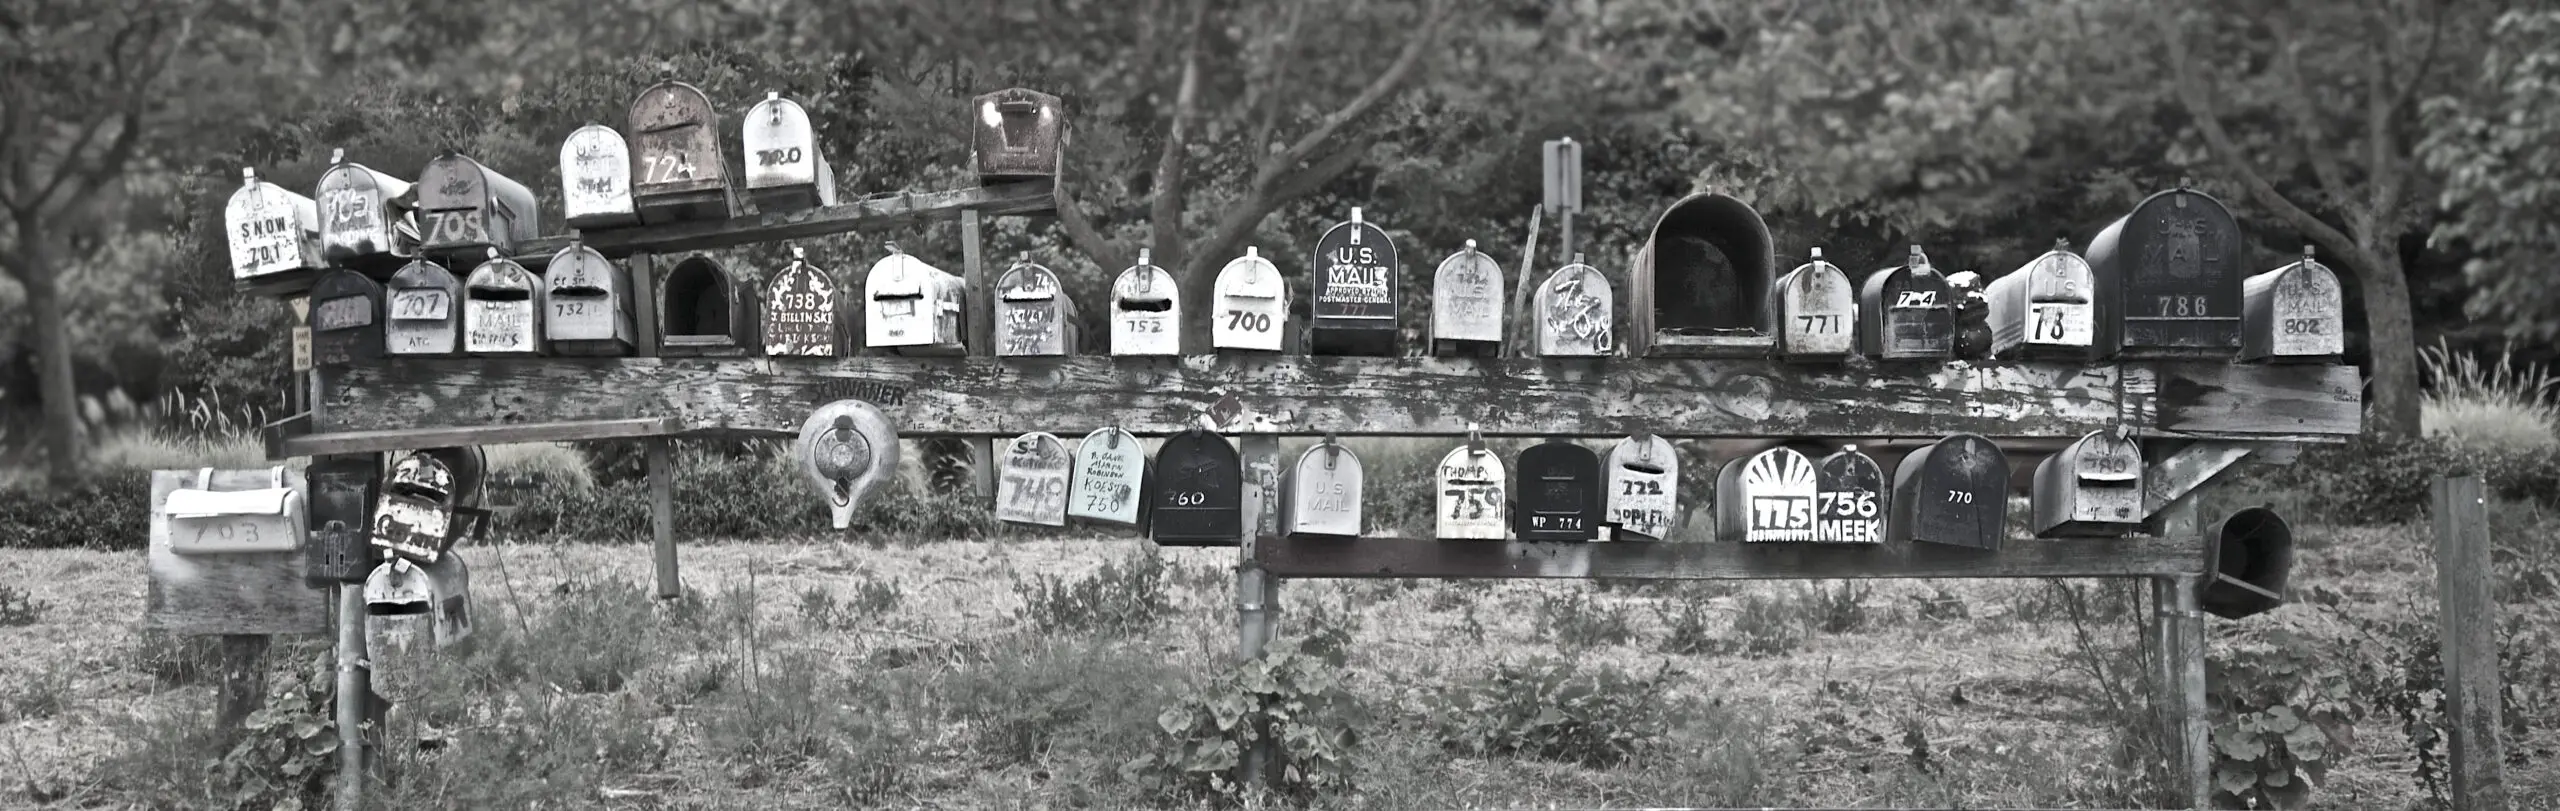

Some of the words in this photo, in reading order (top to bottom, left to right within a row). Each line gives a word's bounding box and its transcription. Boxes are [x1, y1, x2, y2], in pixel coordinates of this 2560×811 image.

[643, 155, 696, 183] 724
[241, 217, 286, 239] SNOW
[425, 211, 487, 245] 709
[249, 245, 280, 264] 701
[1339, 246, 1377, 264] U.S.
[1328, 266, 1383, 285] MAIL
[401, 293, 440, 315] 707
[785, 293, 815, 310] 738
[1319, 296, 1362, 304] POSTMASTER
[1364, 296, 1392, 304] GENERAL
[2159, 295, 2208, 316] 786
[2287, 301, 2326, 313] MAIL
[556, 303, 583, 317] 732
[780, 312, 833, 323] BIELINSKI
[479, 314, 520, 327] MAIL
[1126, 320, 1163, 332] 752
[1228, 309, 1271, 333] 700
[1798, 315, 1839, 334] 771
[2285, 318, 2320, 335] 802
[1622, 480, 1664, 496] 772
[1948, 490, 1973, 504] 770
[1086, 495, 1119, 513] 750
[1165, 489, 1205, 506] 760
[1307, 498, 1350, 512] MAIL
[1444, 486, 1503, 520] 759
[1818, 491, 1878, 518] 756
[1754, 499, 1810, 528] 775
[1532, 516, 1547, 528] WP
[1559, 517, 1582, 530] 774
[1819, 519, 1881, 542] MEEK
